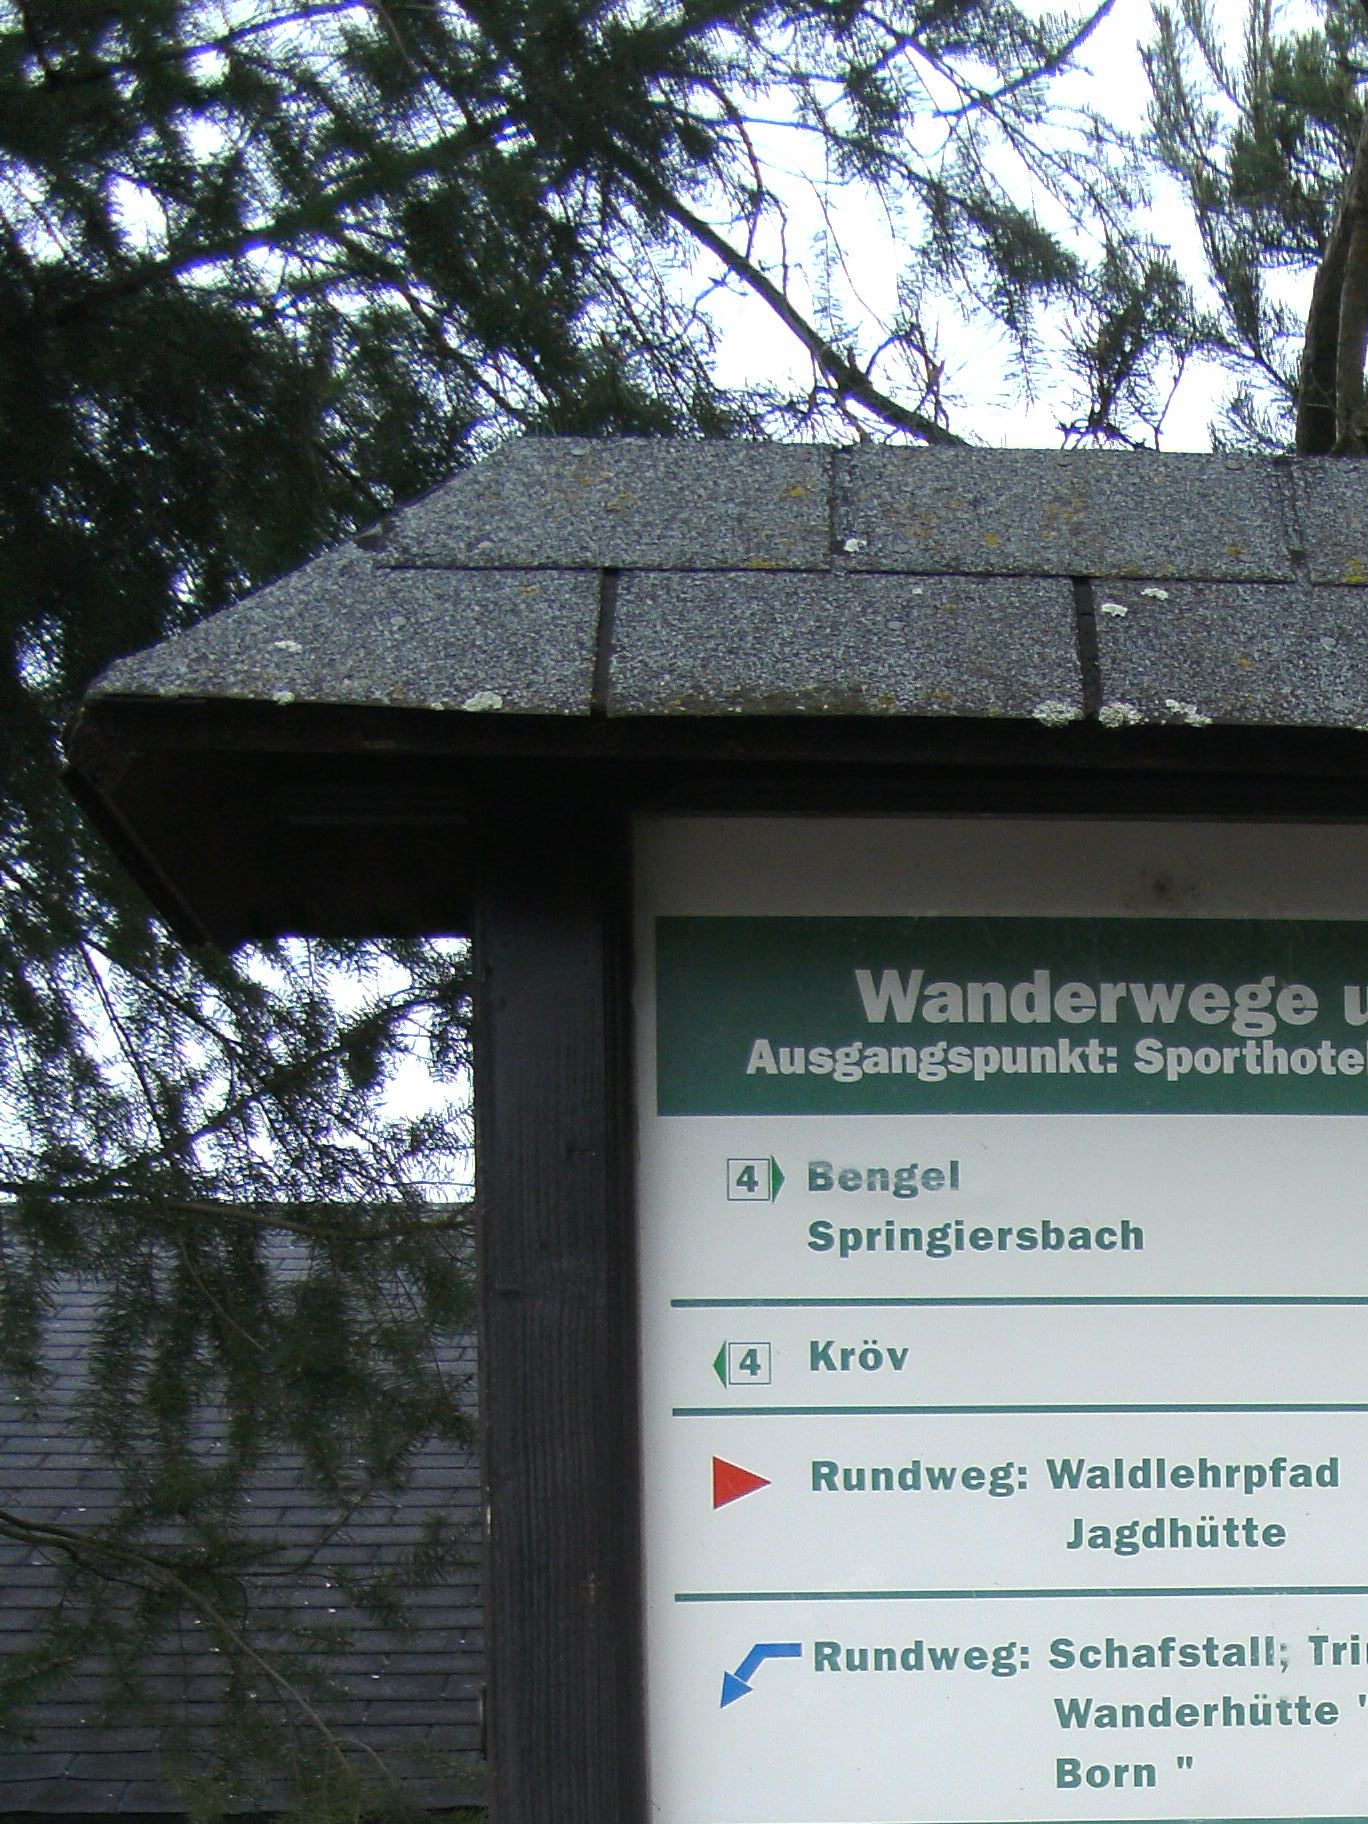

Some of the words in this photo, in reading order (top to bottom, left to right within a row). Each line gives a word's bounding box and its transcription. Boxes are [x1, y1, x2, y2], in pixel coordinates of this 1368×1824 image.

[854, 969, 1319, 1038] Wanderwege
[745, 1037, 1118, 1083] Ausgangspunkt:
[735, 1164, 759, 1193] 4
[807, 1159, 960, 1199] Bengel
[807, 1219, 1144, 1259] Springiersbach
[738, 1348, 762, 1377] 4
[809, 1340, 909, 1372] Kröv
[811, 1459, 1027, 1498] Rundweg:
[1045, 1456, 1339, 1495] Waldlehrpfad
[1066, 1517, 1287, 1557] Jagdhütte
[814, 1639, 1030, 1678] Rundweg:
[1048, 1635, 1289, 1674] Schafstall;
[1053, 1695, 1339, 1729] Wanderhütte
[1056, 1757, 1156, 1789] Born
